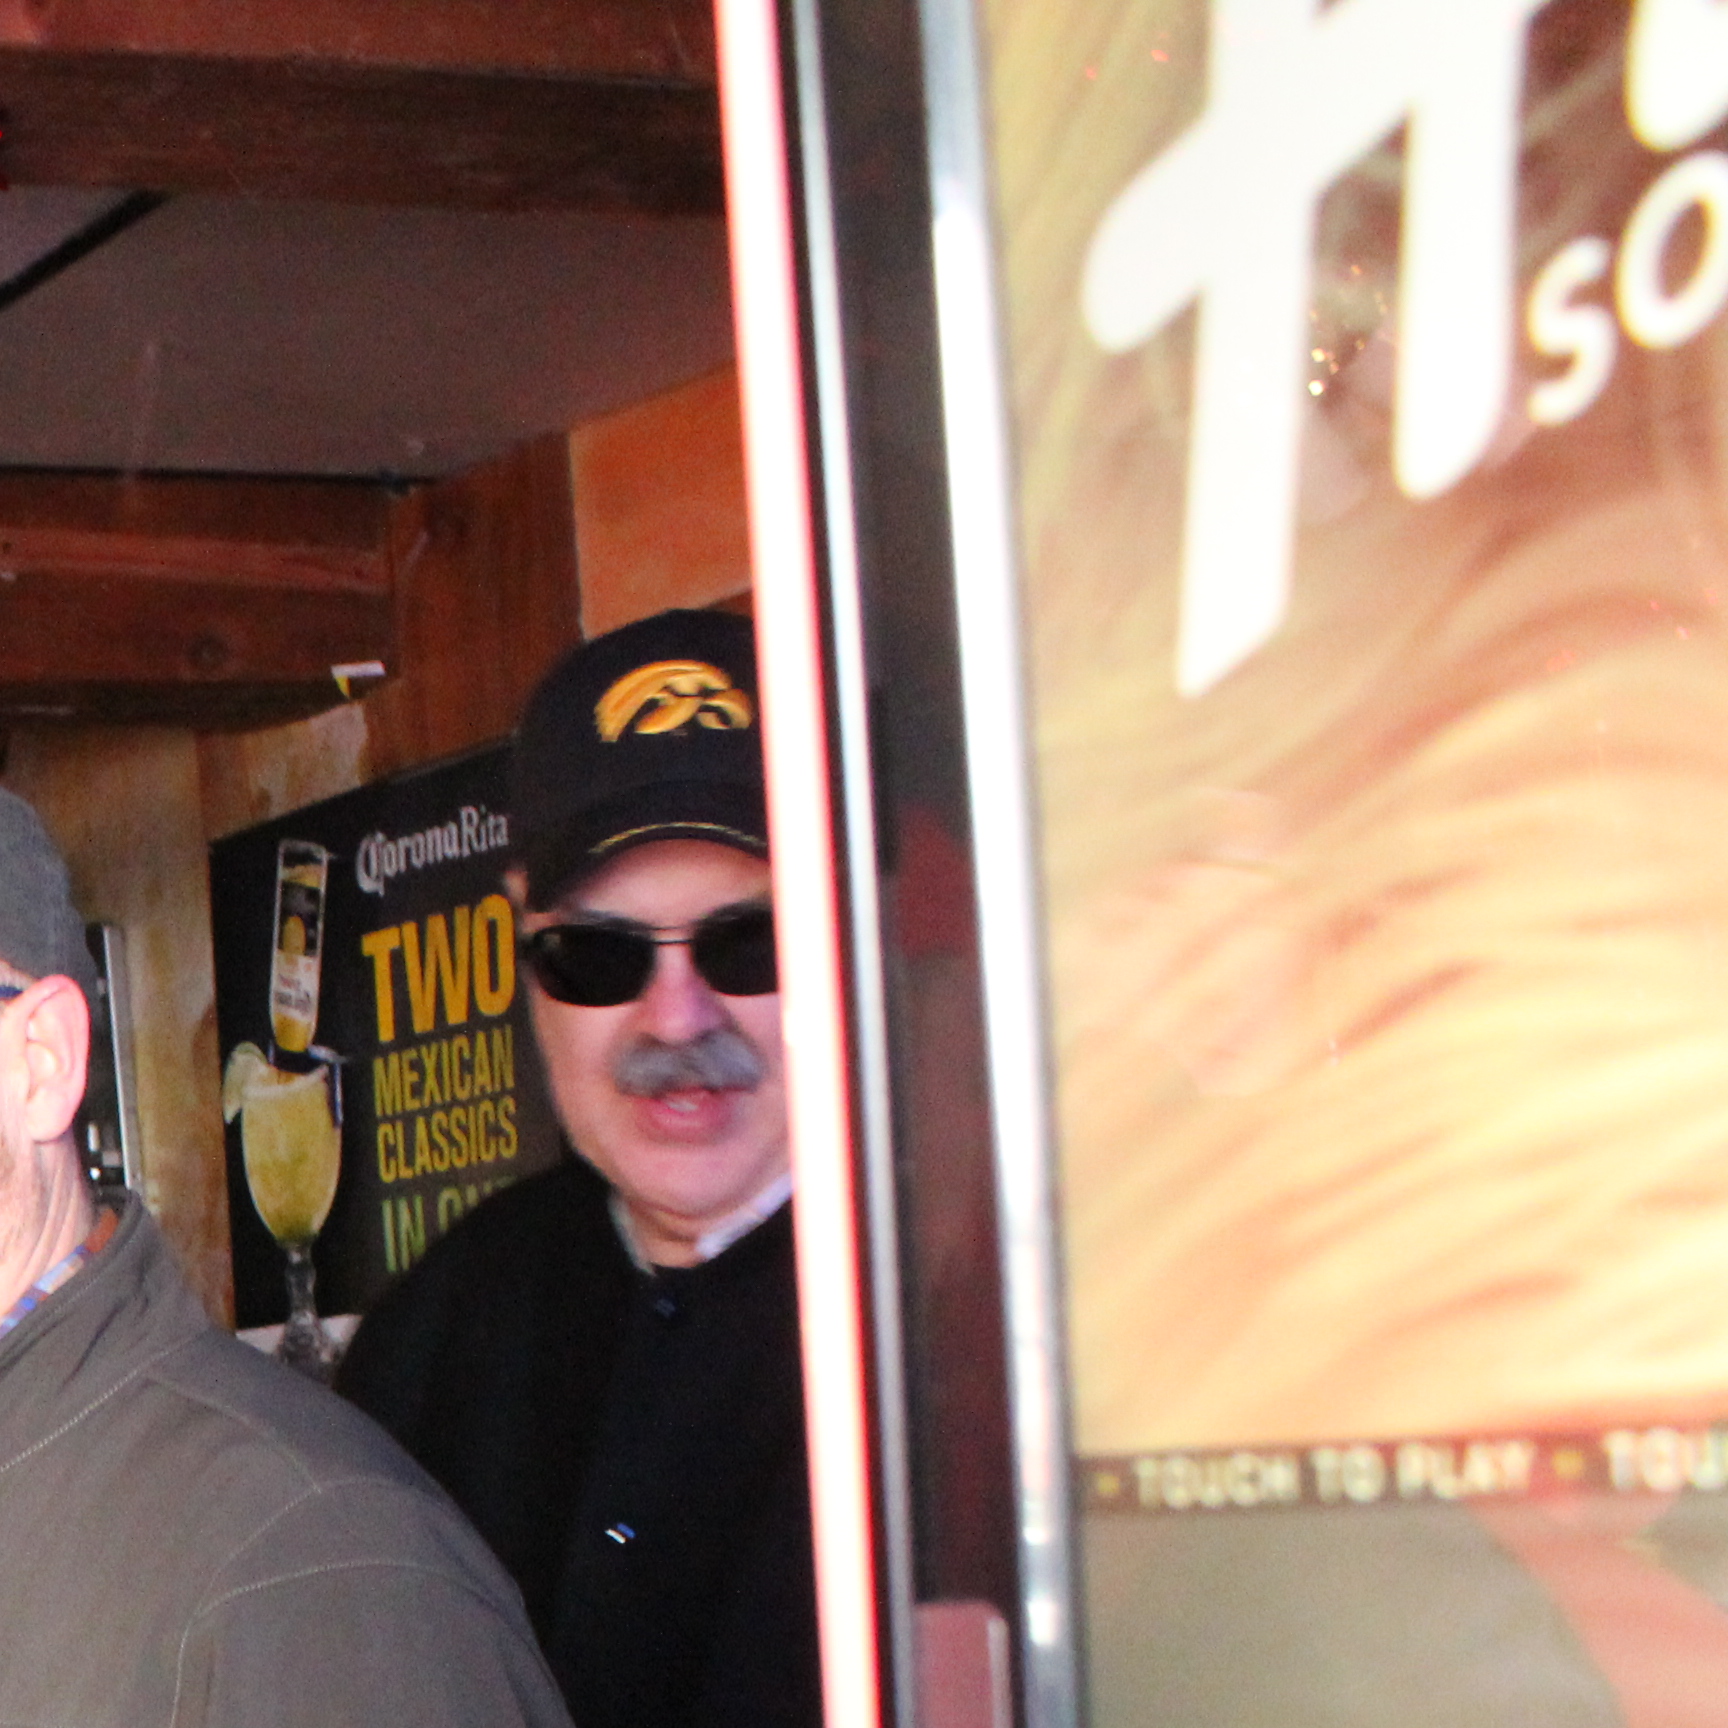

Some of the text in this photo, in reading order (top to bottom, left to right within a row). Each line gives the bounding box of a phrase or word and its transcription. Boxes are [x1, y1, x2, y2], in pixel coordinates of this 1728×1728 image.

[356, 804, 510, 898] CoronaRita
[361, 893, 516, 1043] TWO
[372, 1023, 516, 1118] MEXICAN
[376, 1095, 519, 1184] CLASSICS
[381, 1193, 427, 1274] IN
[1132, 1455, 1300, 1510] TOUCH
[1310, 1446, 1387, 1504] TO
[1396, 1439, 1535, 1500] PLAY
